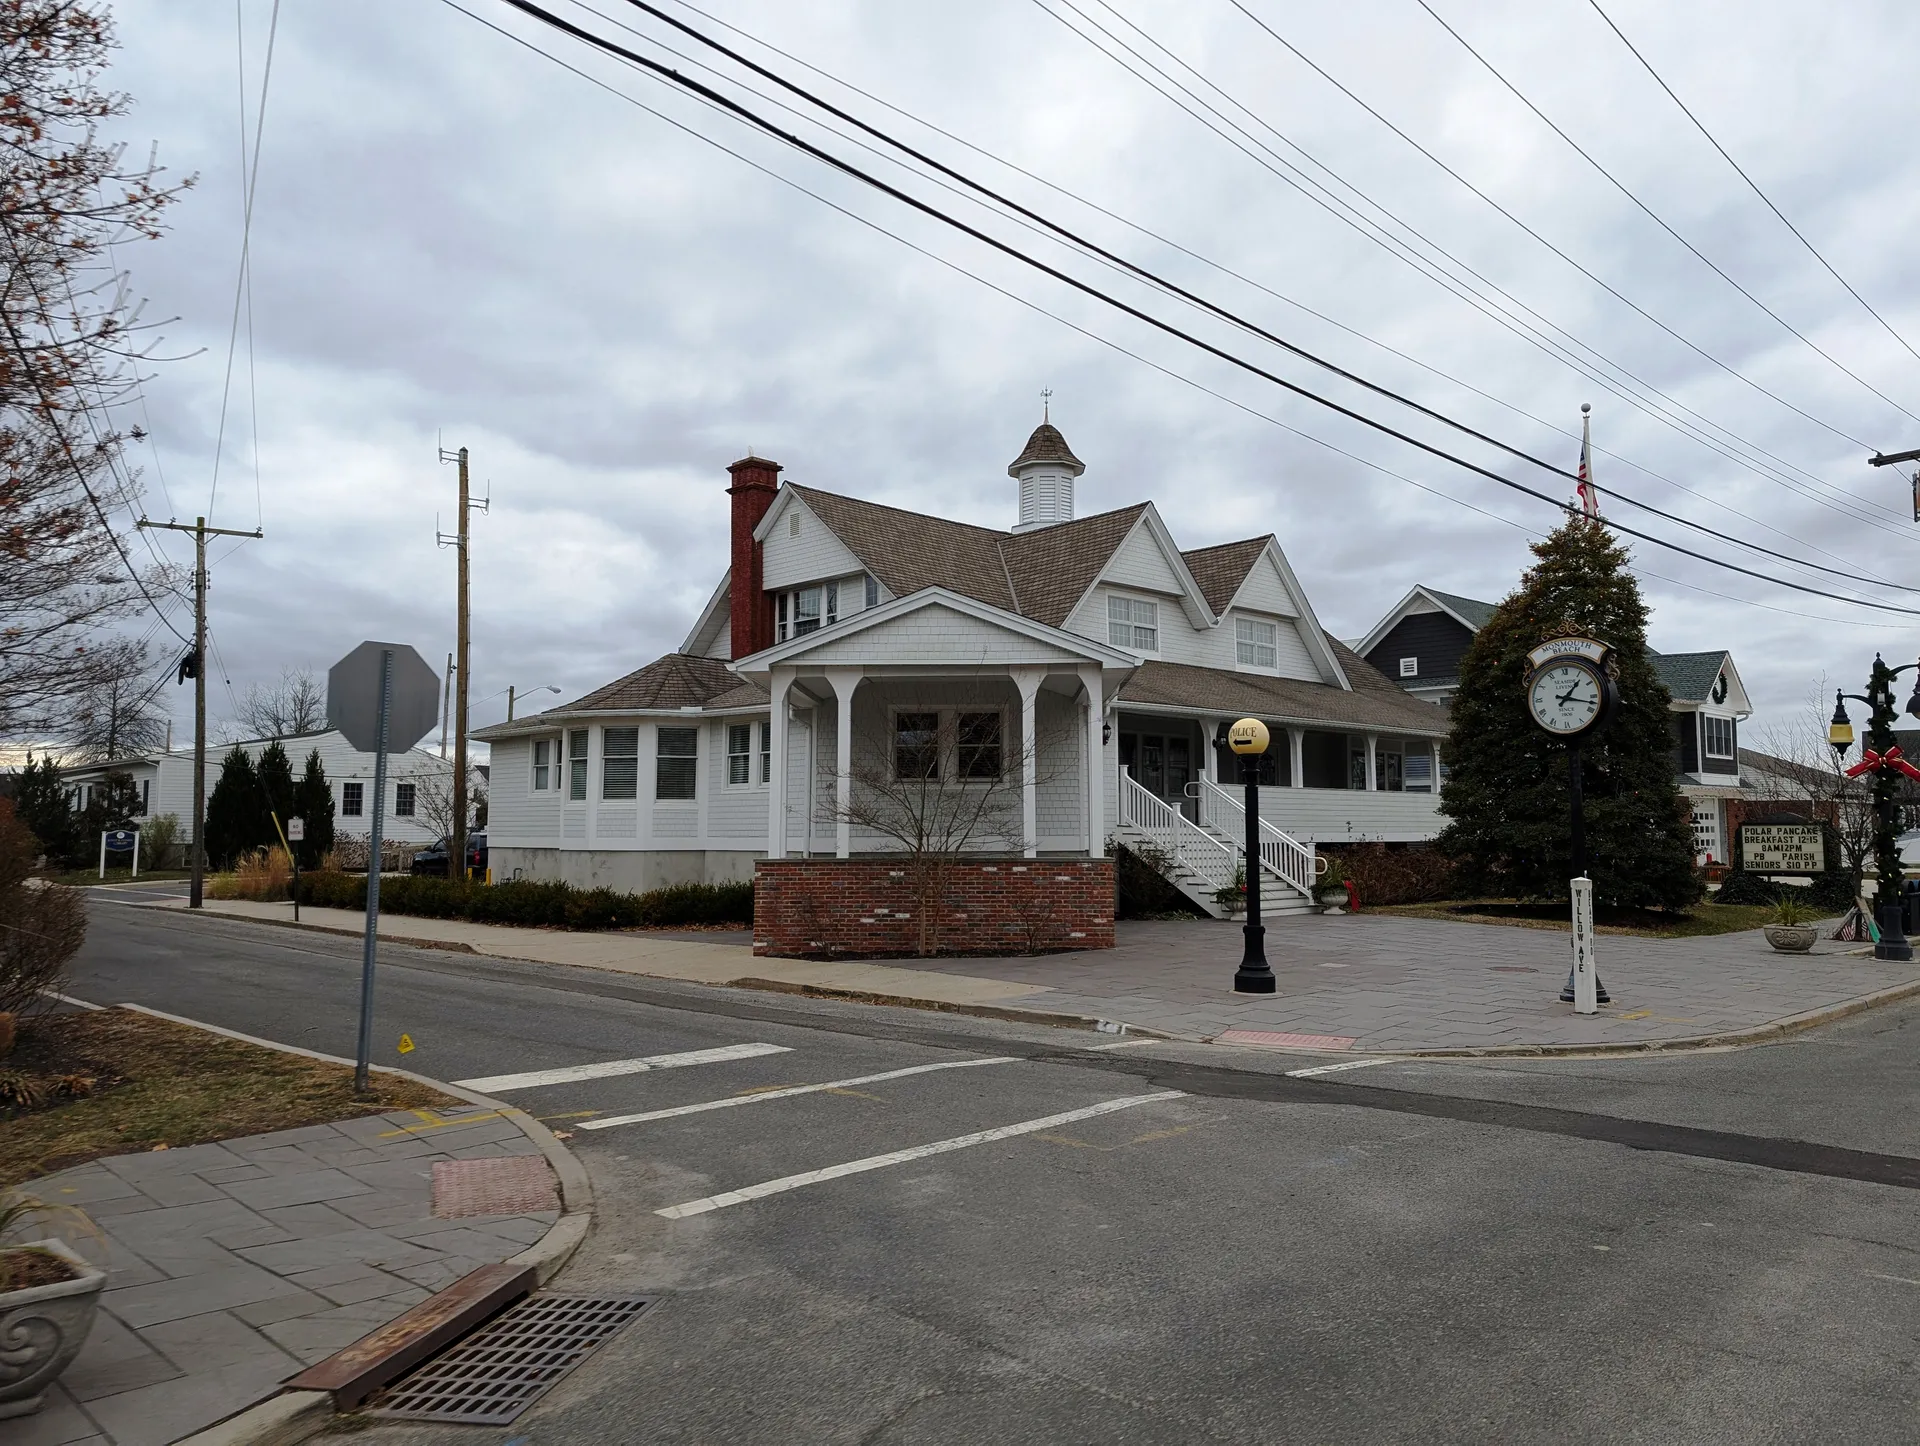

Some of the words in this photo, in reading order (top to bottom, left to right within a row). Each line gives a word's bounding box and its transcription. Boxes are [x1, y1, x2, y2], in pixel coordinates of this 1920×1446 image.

[1542, 640, 1592, 653] MONMOUTH
[1553, 646, 1580, 655] BEACH
[1744, 827, 1772, 835] POLAR
[1777, 827, 1818, 835] PANCAKE
[1744, 836, 1794, 844] BREAKFAST
[1745, 861, 1781, 869] SENIORS
[1575, 889, 1584, 941] WILLOW
